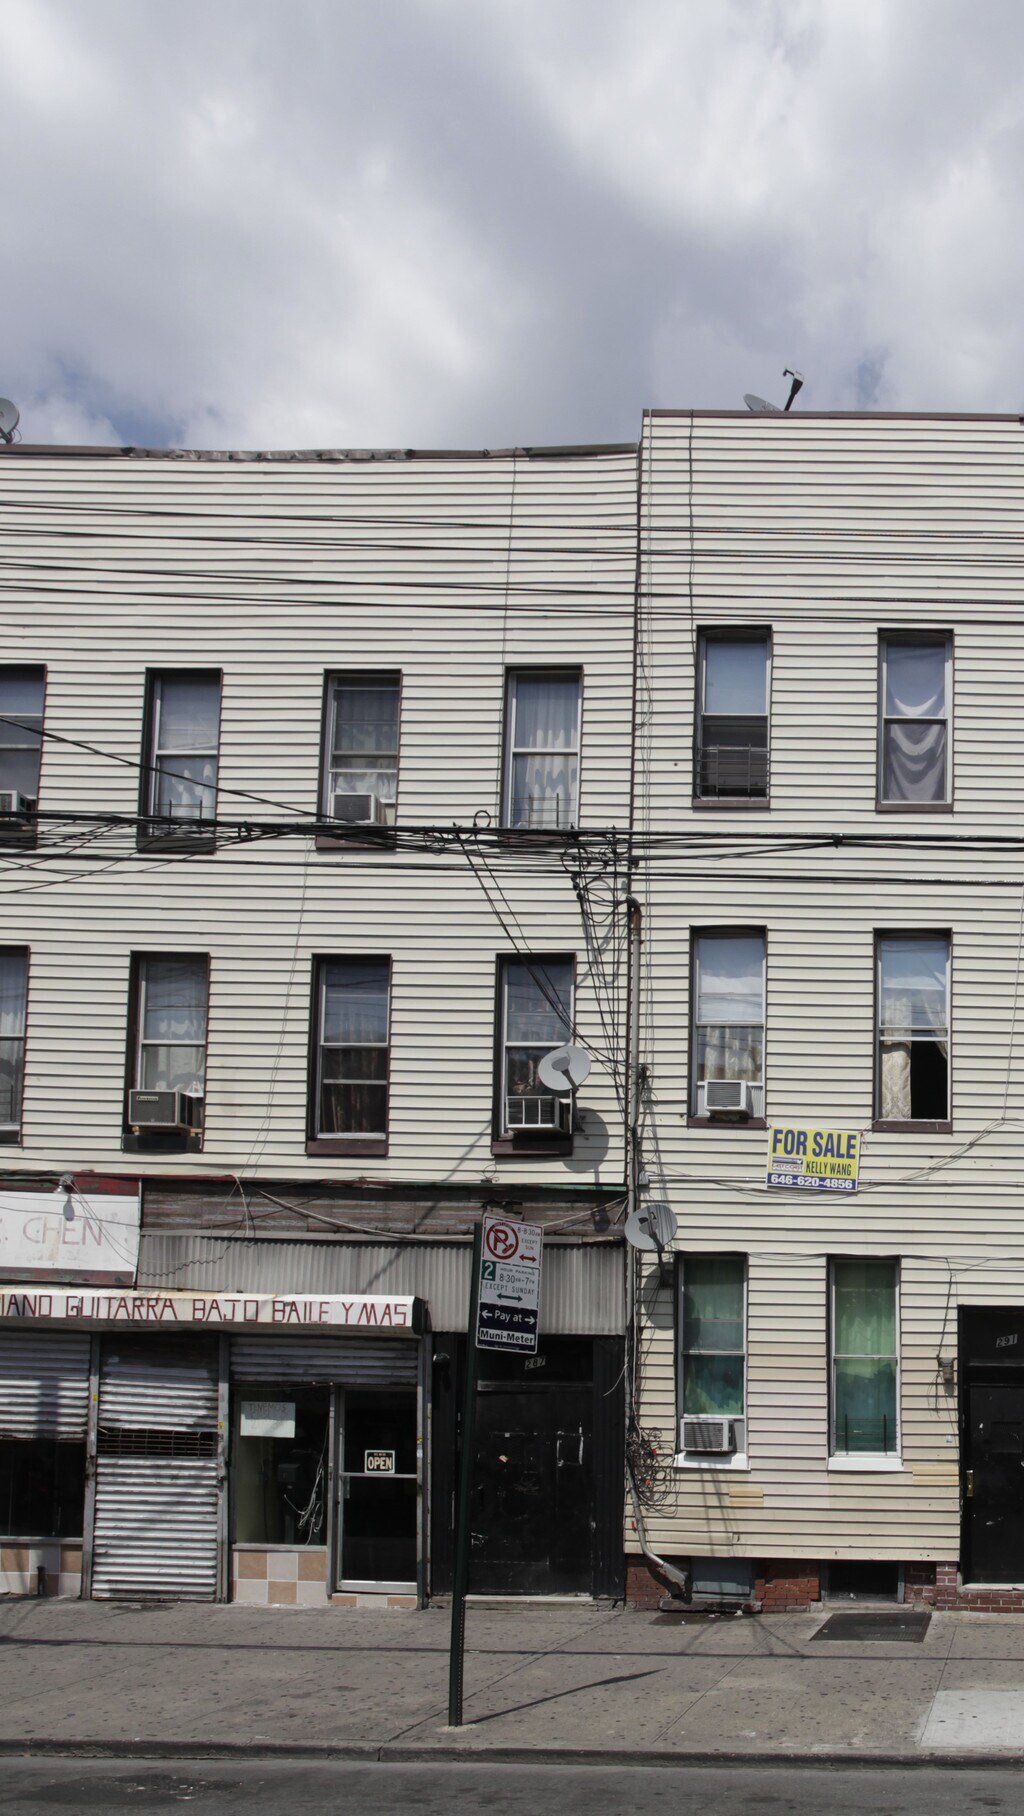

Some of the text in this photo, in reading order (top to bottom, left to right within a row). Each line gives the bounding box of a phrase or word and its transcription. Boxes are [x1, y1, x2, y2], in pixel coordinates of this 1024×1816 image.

[772, 1129, 857, 1159] FOR SALE
[806, 1161, 852, 1176] KELLY WANG
[771, 1174, 853, 1189] 646-620-4856
[22, 1216, 104, 1246] CHEN
[484, 1261, 494, 1279] 2
[484, 1282, 535, 1296] EXCEPT SUNDAY
[66, 1296, 178, 1320] GUITARRA
[192, 1299, 258, 1322] BAJO
[494, 1309, 522, 1323] Pay at
[480, 1329, 534, 1344] Muni-Meter
[998, 1334, 1017, 1347] 291
[526, 1357, 545, 1368] 287
[367, 1456, 392, 1470] OPEN
